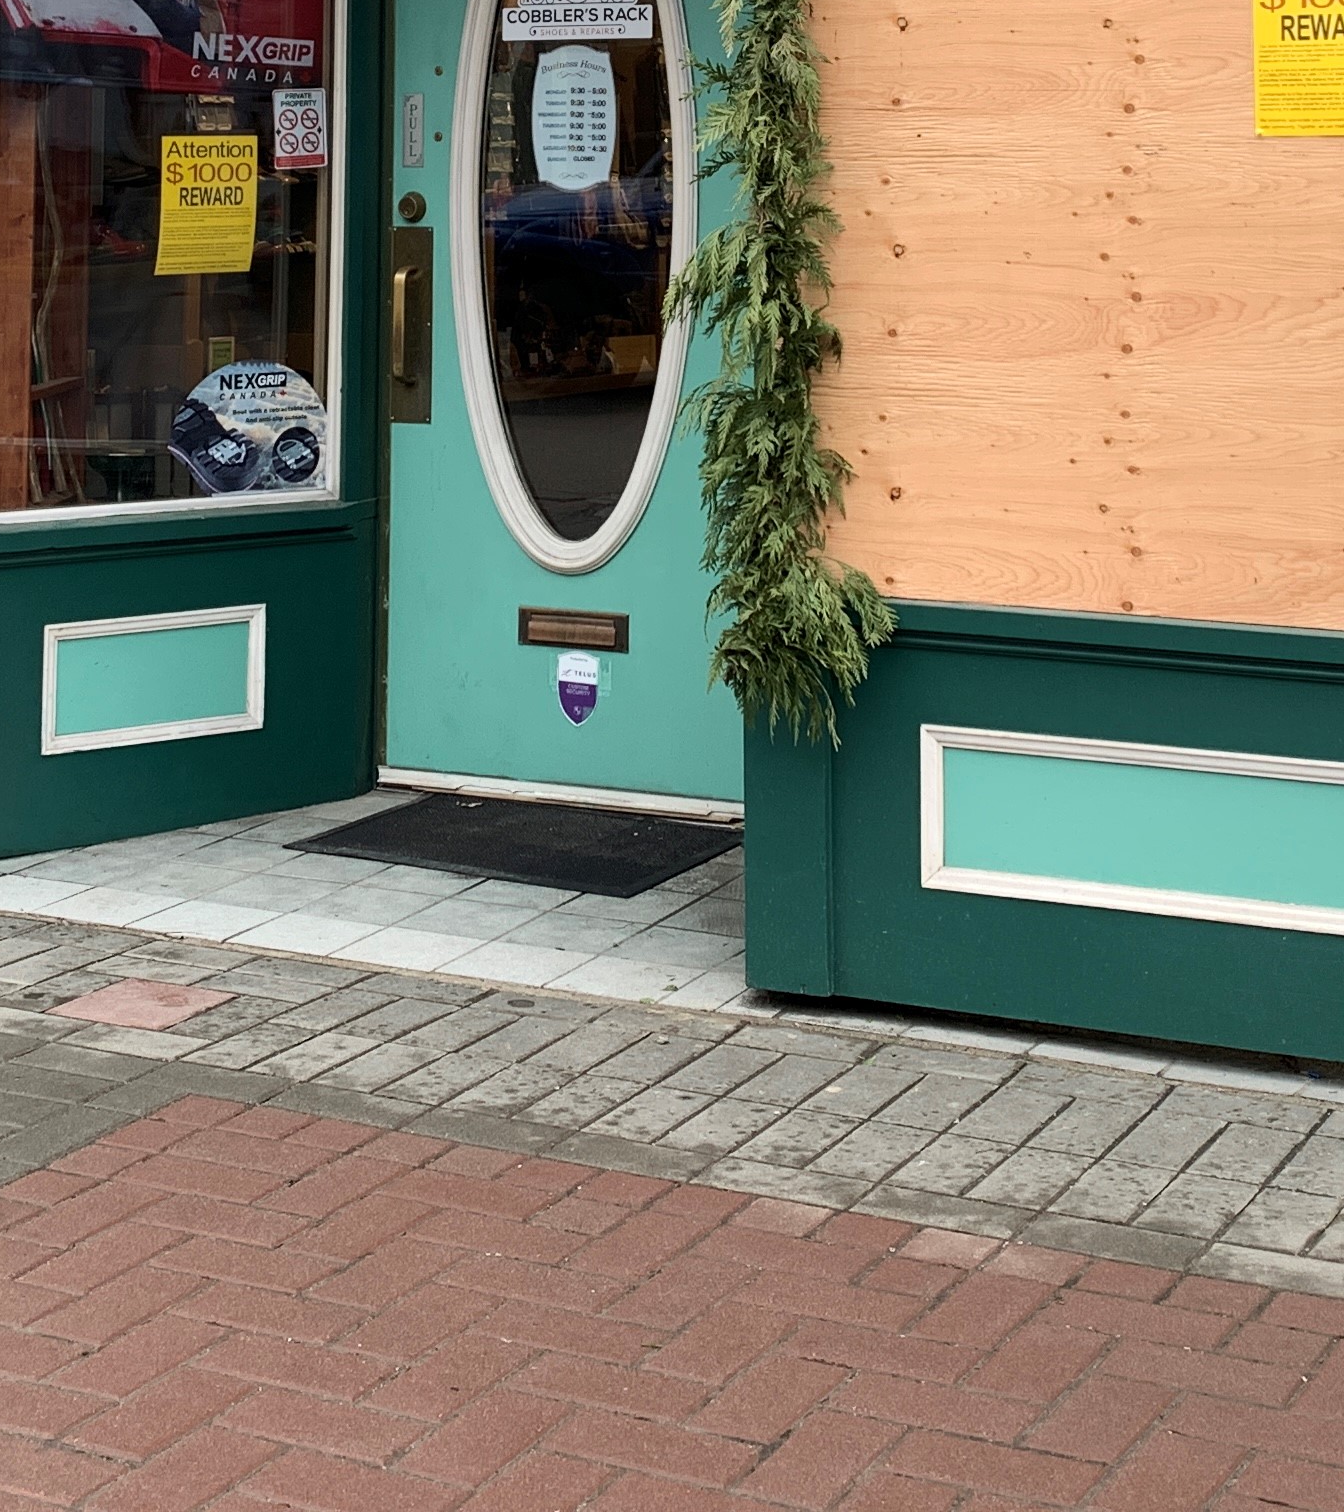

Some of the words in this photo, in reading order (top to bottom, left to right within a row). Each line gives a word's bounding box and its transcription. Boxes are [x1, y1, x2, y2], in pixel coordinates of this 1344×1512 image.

[507, 8, 599, 24] COBBLER'S
[603, 6, 649, 22] RACK
[540, 28, 568, 37] SHOES
[580, 27, 615, 36] REPAIRS
[191, 64, 293, 84] CANADA
[541, 60, 578, 75] Business
[580, 59, 607, 74] Hours
[284, 92, 312, 100] PRIVATE
[409, 104, 418, 157] PULL
[166, 140, 253, 158] Attention
[179, 186, 244, 207] REWARD
[219, 390, 277, 401] CANADA
[574, 670, 596, 678] TELUS
